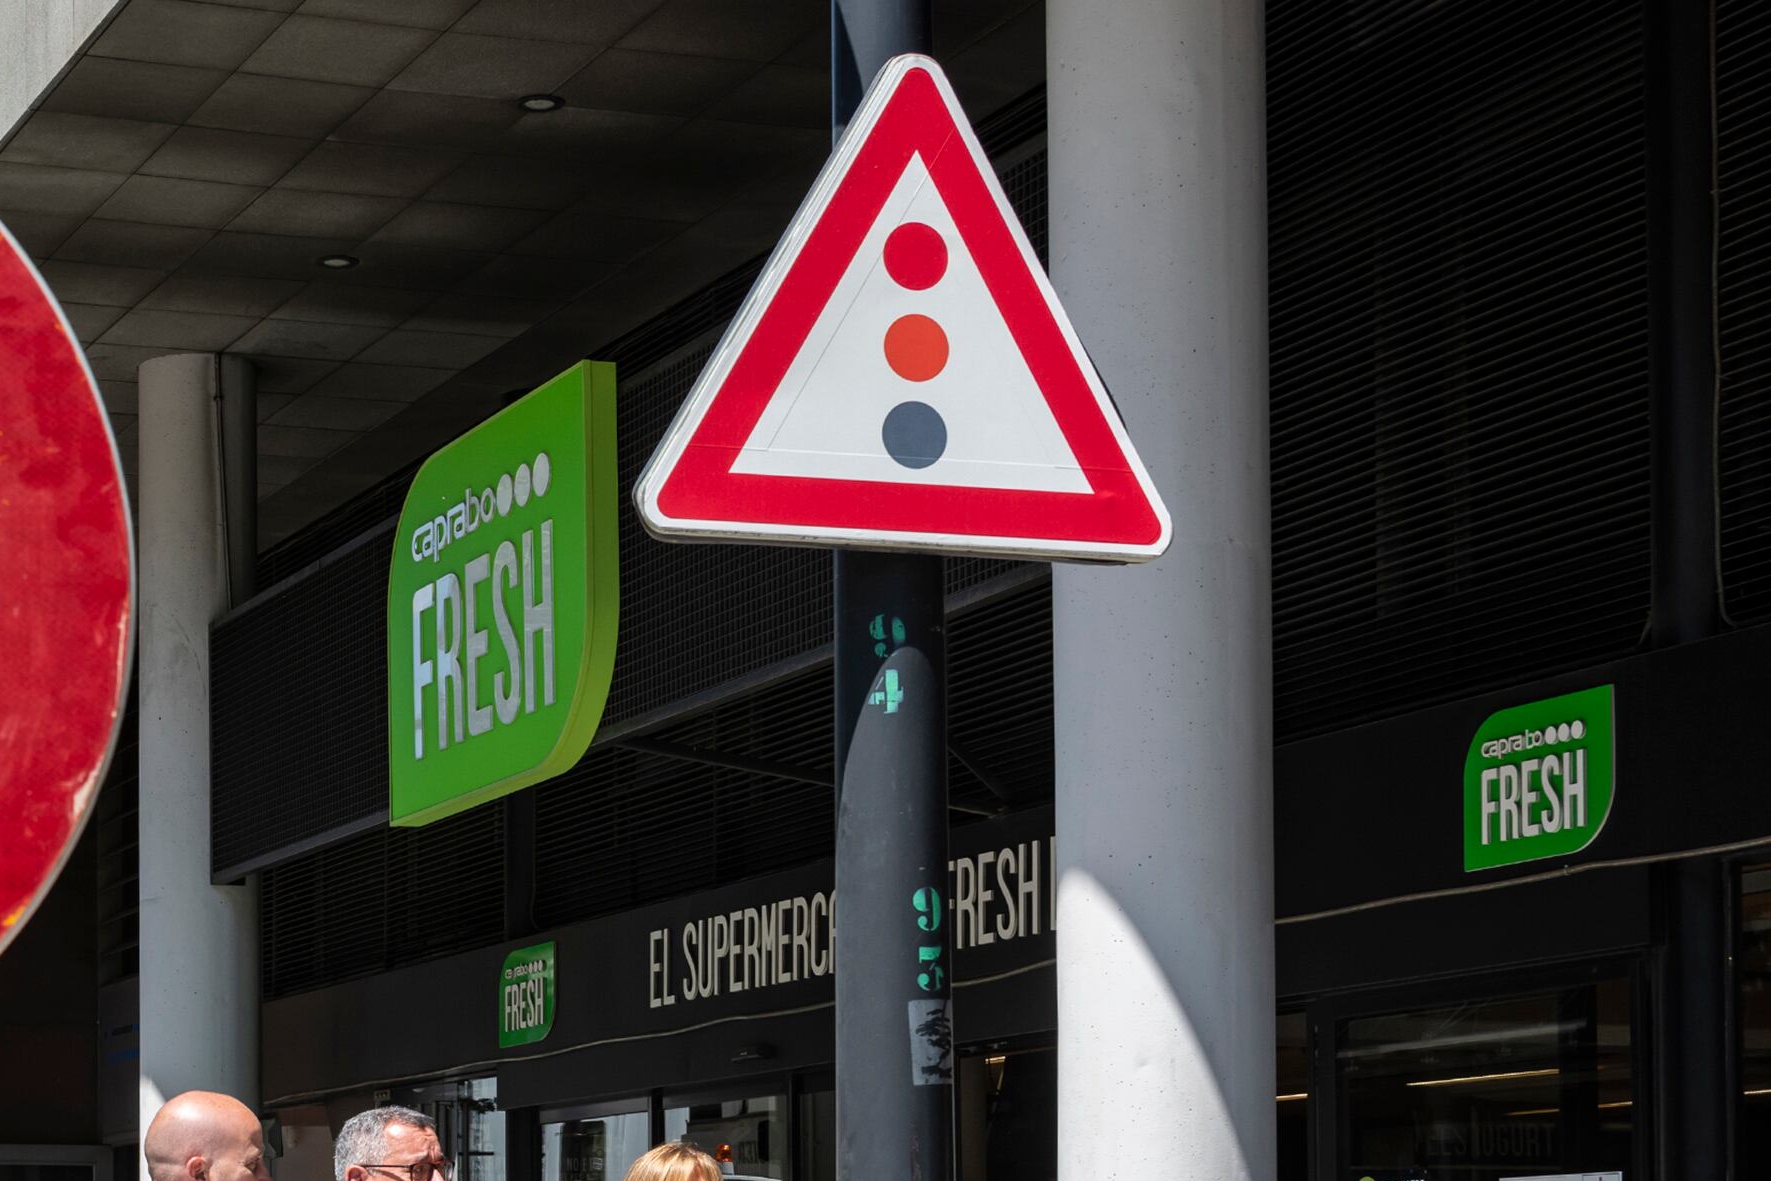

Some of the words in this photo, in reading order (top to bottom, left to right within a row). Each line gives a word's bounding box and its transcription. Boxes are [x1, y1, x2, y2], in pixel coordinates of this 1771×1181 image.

[411, 488, 496, 562] caprabo
[412, 519, 557, 760] FRESH
[1481, 729, 1544, 759] caprabo
[1481, 749, 1586, 845] FRESH
[505, 977, 544, 1033] FRESH
[649, 928, 675, 1009] EL
